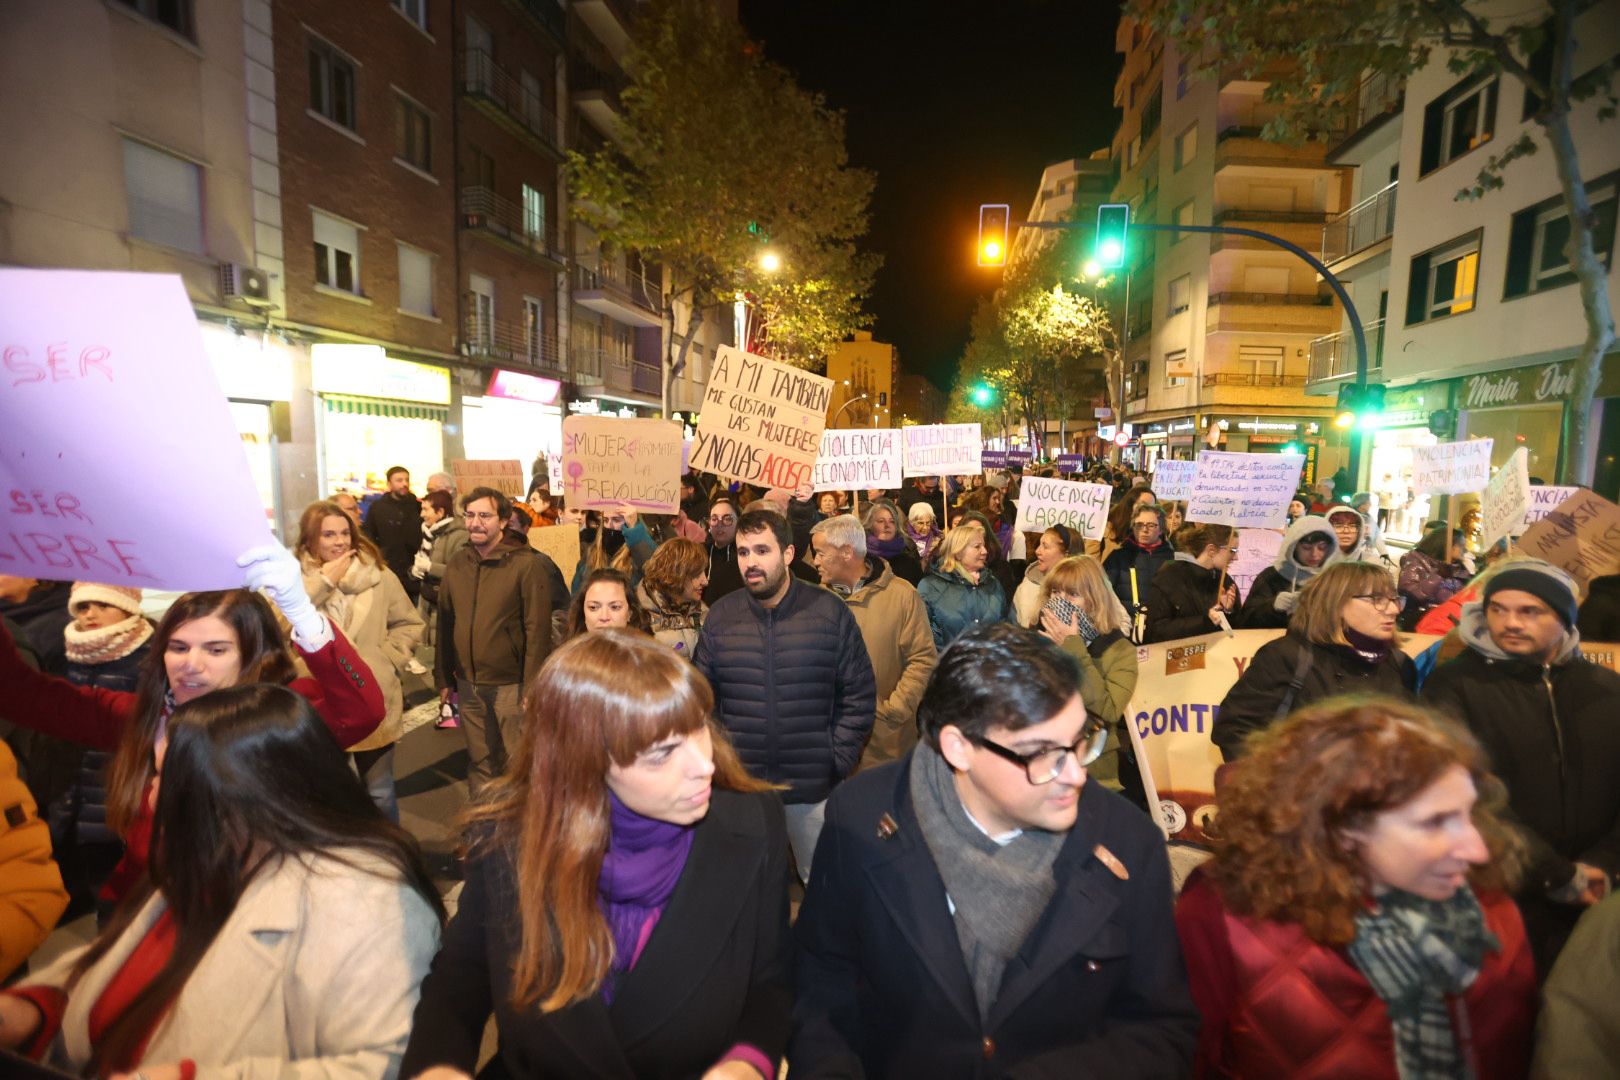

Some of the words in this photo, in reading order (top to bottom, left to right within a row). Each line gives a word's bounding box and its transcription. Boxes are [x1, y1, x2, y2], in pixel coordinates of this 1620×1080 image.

[3, 341, 113, 387] SER
[713, 354, 729, 383] A
[736, 358, 763, 393] MI
[707, 387, 726, 405] ME
[729, 394, 776, 418] GUSTAN
[574, 432, 629, 457] MUJER
[690, 430, 710, 464] Y
[728, 413, 750, 432] LAS
[757, 419, 819, 453] MUJERES
[819, 432, 893, 457] VIOLENCIA
[906, 428, 963, 448] VIOLENCIA
[907, 446, 977, 468] INSTITUCIONAL
[815, 459, 891, 484] ECONÓMICA
[1211, 470, 1247, 480] libertad
[582, 479, 677, 503] REVOLUCIÓN
[9, 488, 95, 525] SER
[1025, 505, 1096, 537] LABORAL
